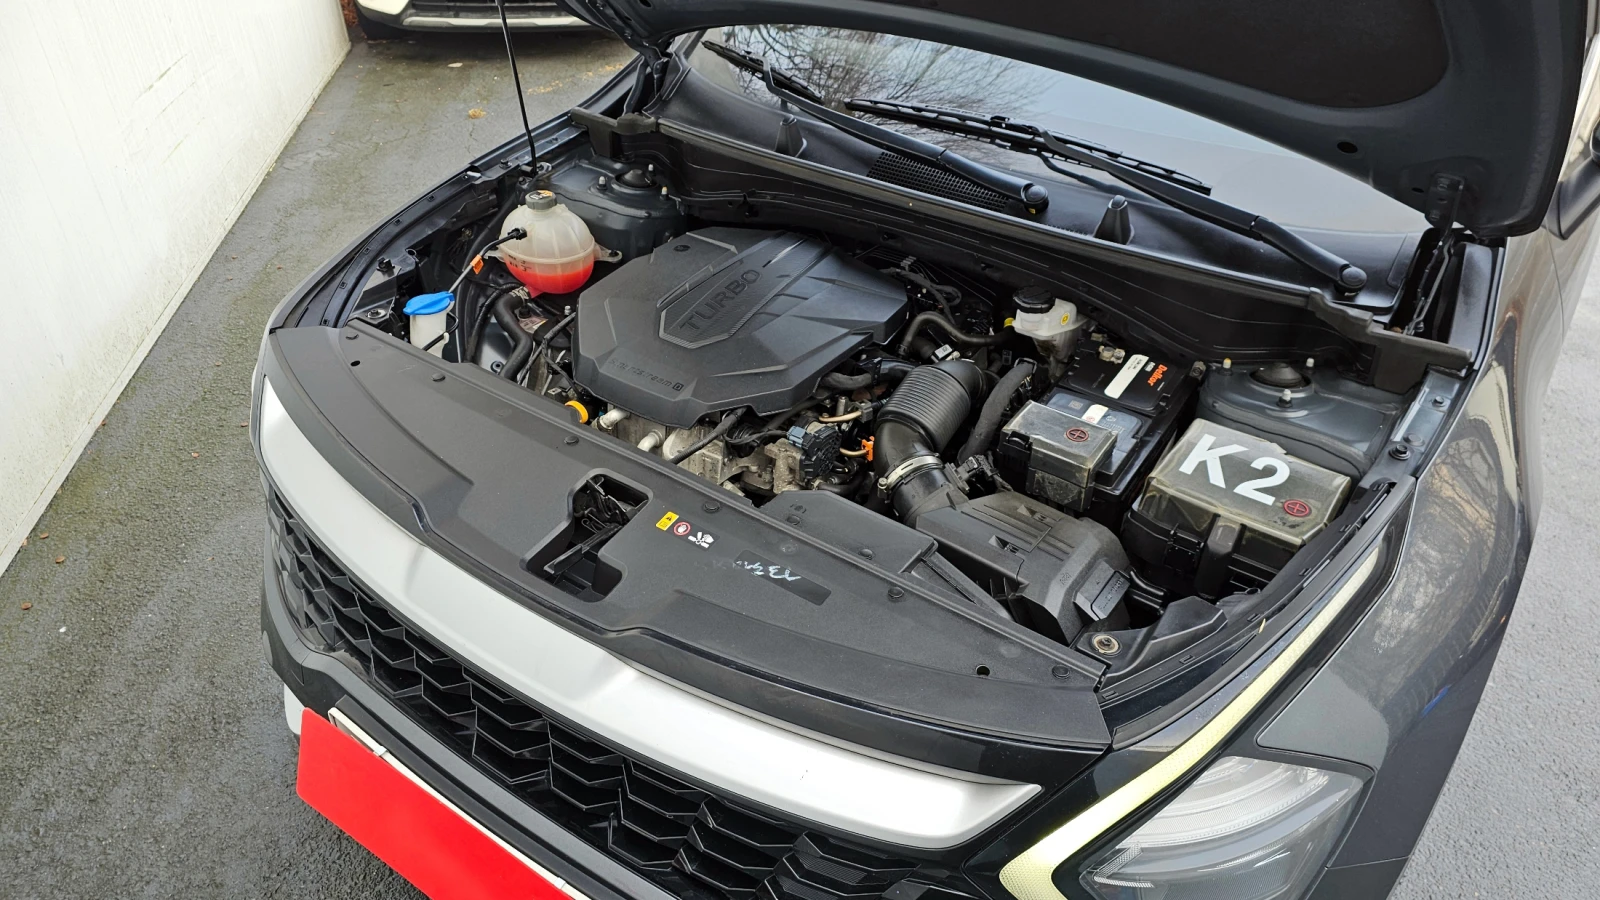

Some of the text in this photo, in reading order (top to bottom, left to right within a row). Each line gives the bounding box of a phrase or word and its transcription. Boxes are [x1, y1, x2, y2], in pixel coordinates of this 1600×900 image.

[679, 269, 760, 330] TURBO
[1147, 364, 1168, 387] Delkor
[1178, 433, 1290, 506] K2
